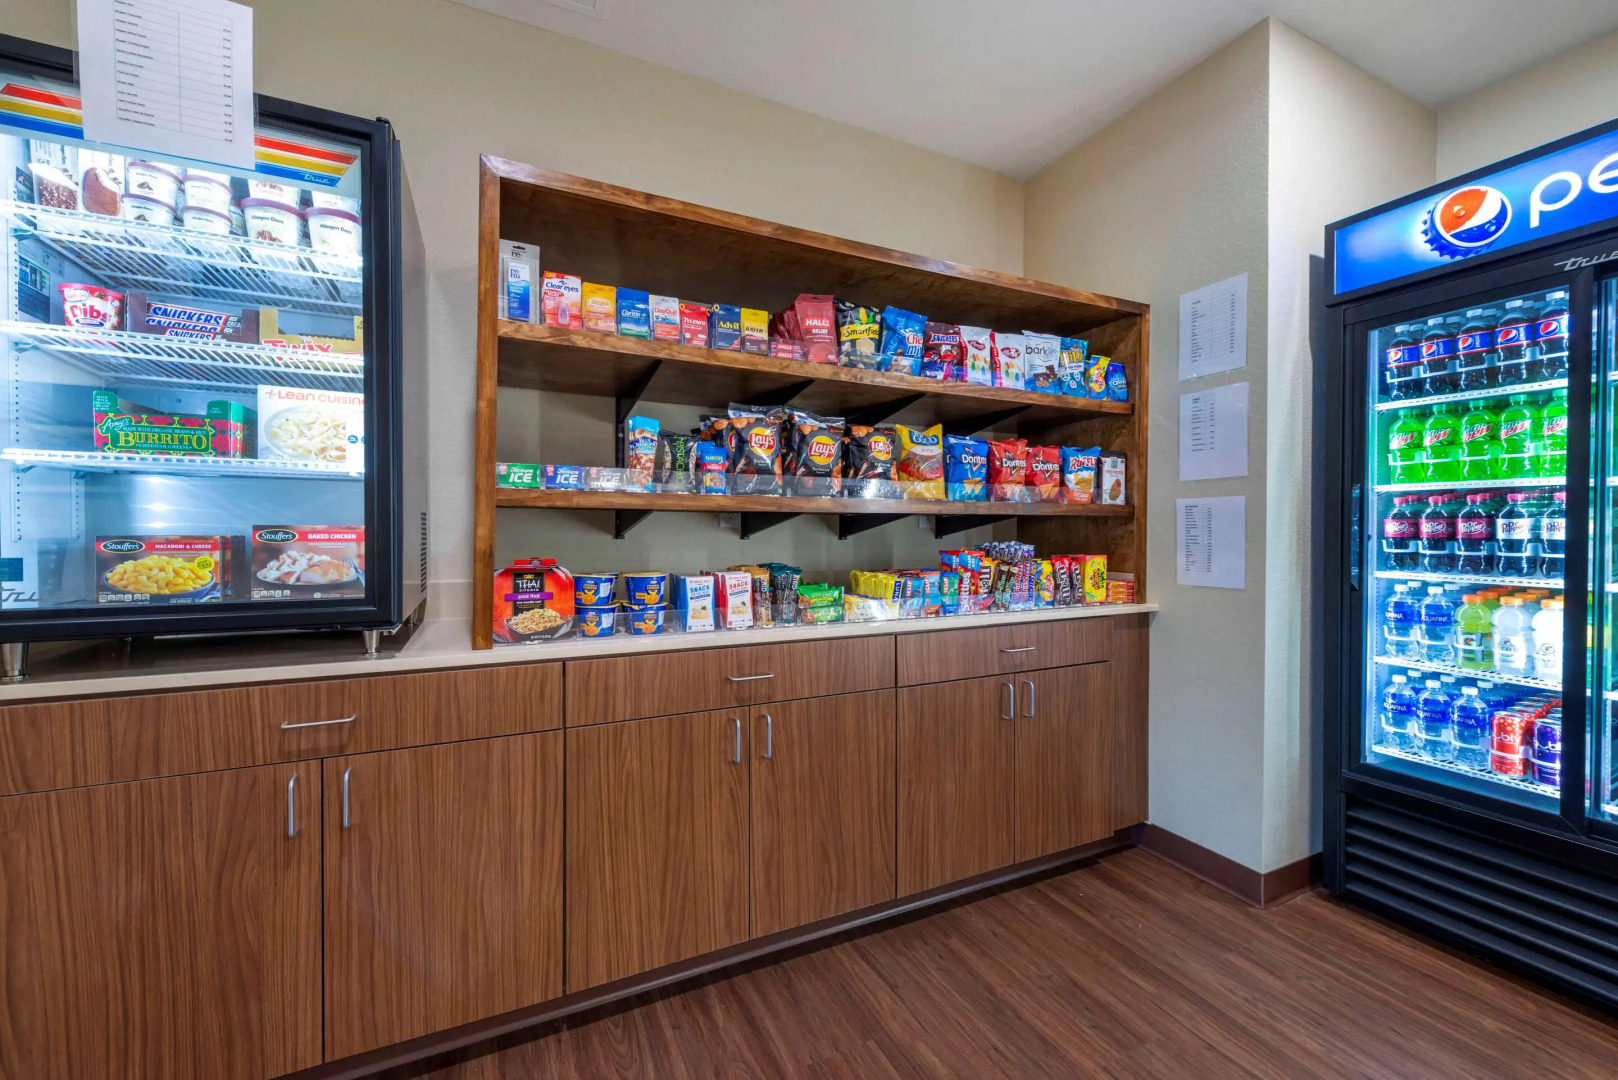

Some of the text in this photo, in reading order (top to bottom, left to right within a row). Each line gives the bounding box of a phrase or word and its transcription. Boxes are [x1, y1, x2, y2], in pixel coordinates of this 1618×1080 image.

[545, 281, 579, 293] Clear eyes
[152, 305, 223, 326] SNICKERS
[719, 320, 740, 330] Advil
[805, 318, 830, 327] HALLS
[168, 329, 212, 341] SNICKERS
[931, 334, 959, 343] SNICKERS
[1026, 345, 1048, 356] bark
[102, 418, 130, 433] Amy's
[117, 431, 207, 450] BURRITO
[1002, 458, 1026, 468] Doritos
[508, 472, 533, 483] ICE
[555, 473, 579, 484] ICE
[260, 531, 293, 541] Stouffer's
[105, 542, 140, 551] Stouffer's
[516, 580, 541, 589] THAI
[690, 585, 710, 593] SNACK
[729, 581, 748, 589] SNACK
[1492, 731, 1521, 742] ubly
